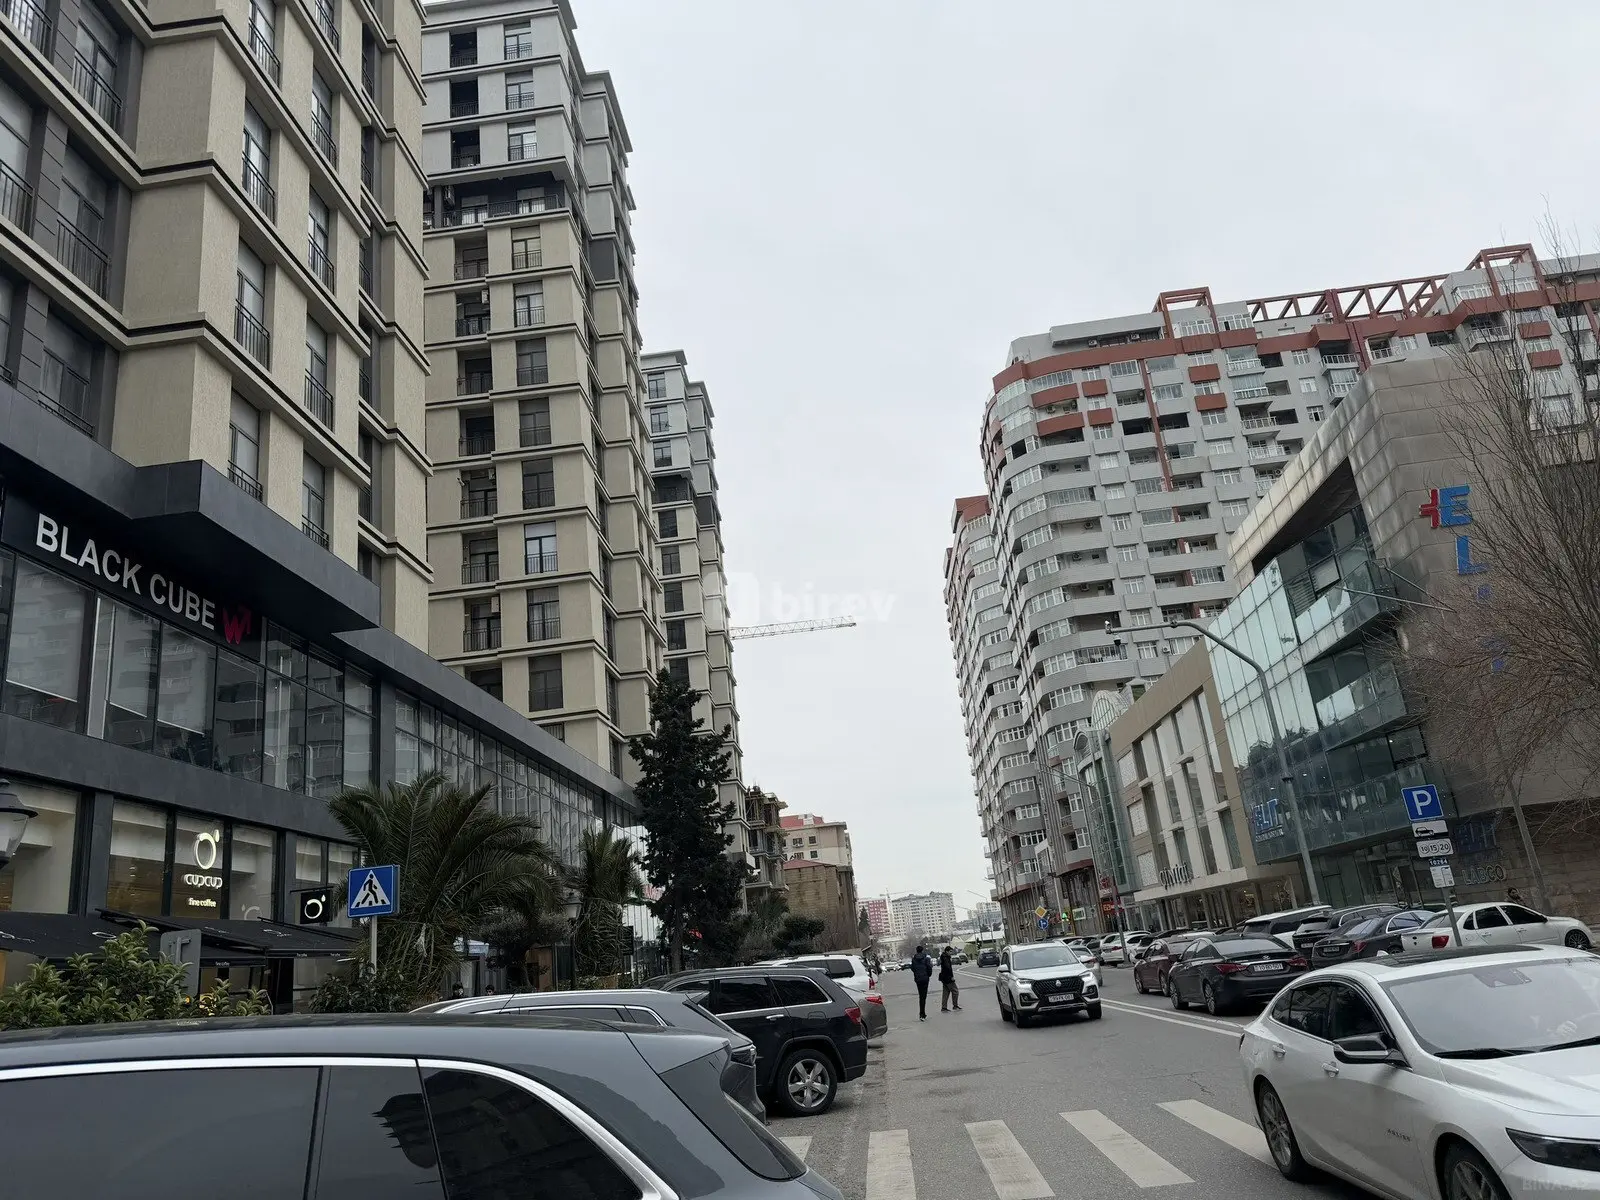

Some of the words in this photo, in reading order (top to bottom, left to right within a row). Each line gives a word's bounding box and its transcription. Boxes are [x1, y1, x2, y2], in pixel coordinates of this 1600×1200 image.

[36, 513, 142, 595] BLACK
[150, 573, 216, 630] CUBE
[1412, 790, 1432, 815] P
[1440, 842, 1448, 850] 20
[188, 897, 200, 907] fine
[200, 898, 217, 908] coffee
